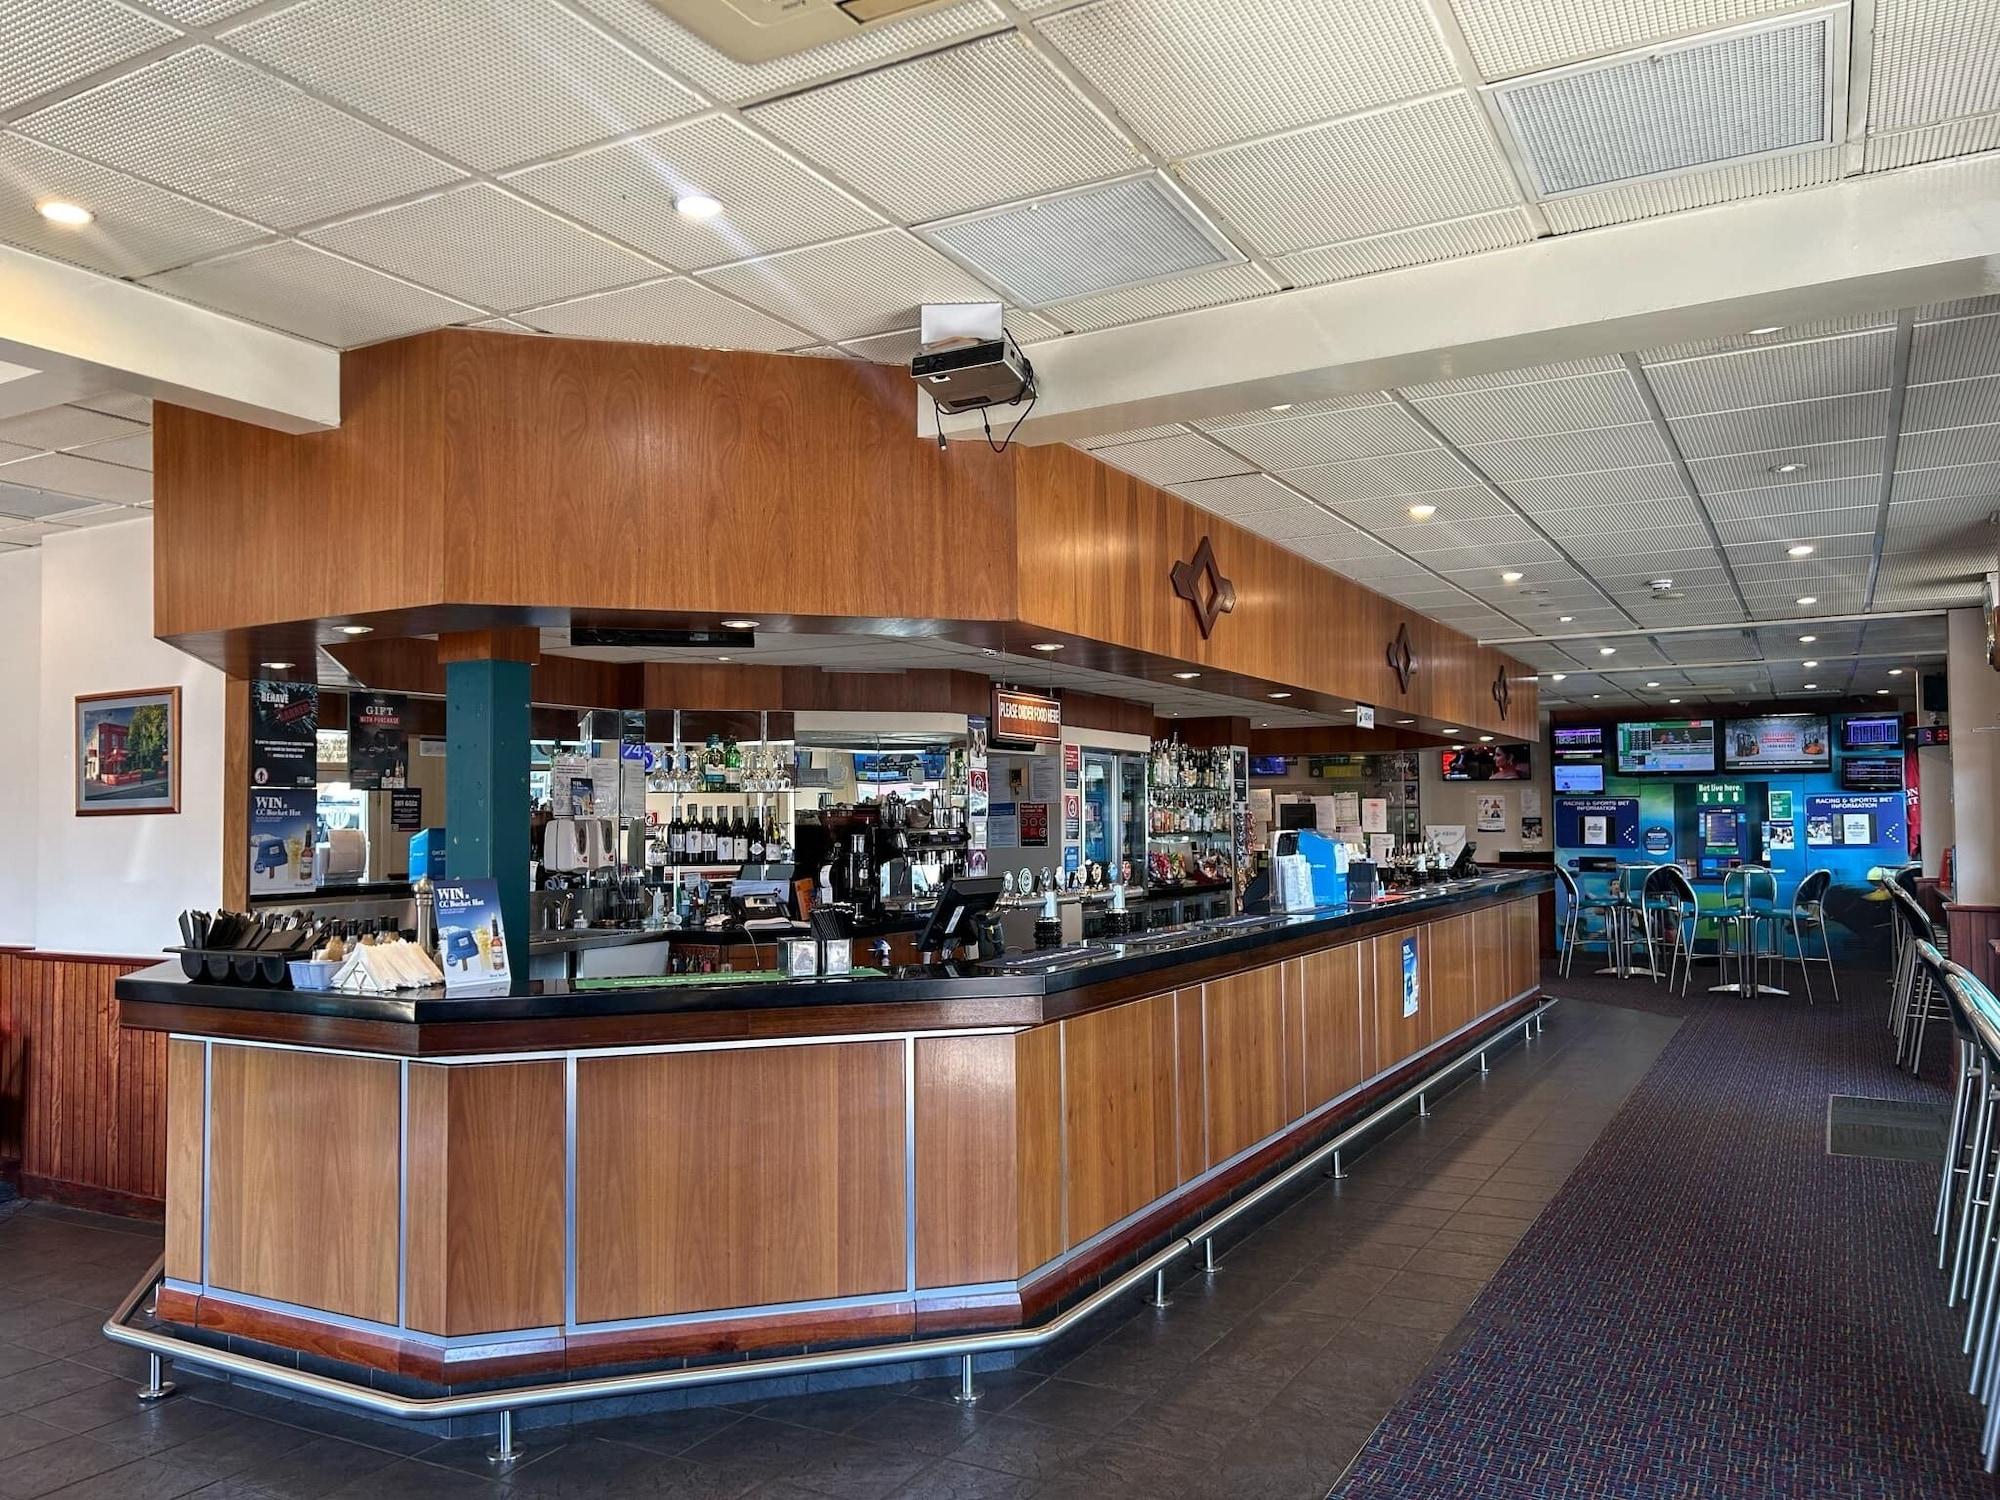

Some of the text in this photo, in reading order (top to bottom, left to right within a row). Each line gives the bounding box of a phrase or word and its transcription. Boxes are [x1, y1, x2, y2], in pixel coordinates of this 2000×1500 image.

[261, 692, 289, 703] BEHAVE
[365, 706, 394, 715] GIFT
[1000, 702, 1059, 724] PLEASE ORDER FOOD HERE
[1698, 784, 1710, 792] Bet
[1711, 784, 1724, 792] live
[255, 808, 301, 816] CC Bucket Hat
[439, 898, 485, 908] CC Bucket Hat
